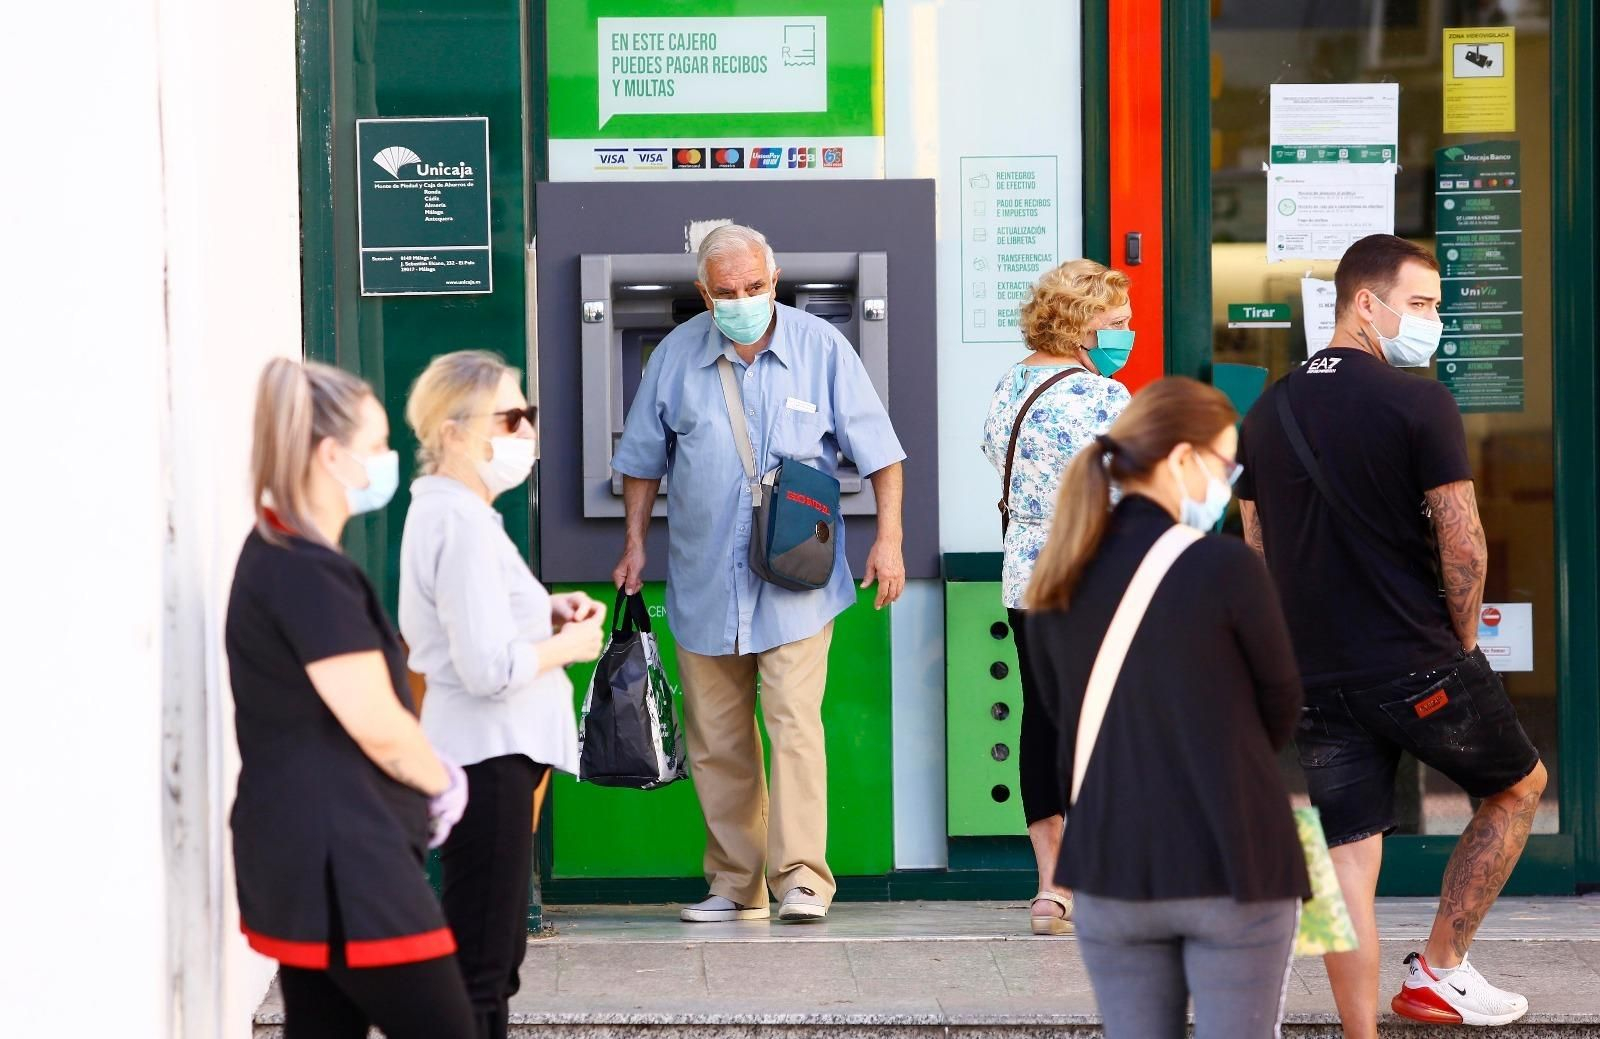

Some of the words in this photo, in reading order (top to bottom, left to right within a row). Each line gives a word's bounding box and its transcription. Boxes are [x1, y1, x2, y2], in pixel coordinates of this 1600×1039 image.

[612, 33, 628, 50] EN
[632, 33, 665, 50] ESTE
[668, 32, 717, 50] CAJERO
[612, 56, 662, 74] PUEDES
[666, 56, 708, 74] PAGAR
[712, 56, 768, 73] RECIBOS
[612, 80, 620, 97] Y
[624, 79, 675, 96] MULTAS
[600, 154, 625, 163] VISA
[638, 153, 663, 162] VISA
[752, 152, 780, 160] UnionPay
[788, 154, 815, 162] JCB
[416, 162, 474, 178] Unicaja
[996, 172, 1036, 180] REINTEGROS
[996, 182, 1005, 190] DE
[1006, 181, 1036, 190] EFECTIVO
[996, 199, 1013, 208] PAGO
[1014, 199, 1023, 208] DE
[1024, 198, 1051, 207] RECIBOS
[996, 209, 1001, 217] E
[1002, 208, 1038, 217] IMPUESTOS
[997, 225, 1046, 235] ACTUALIZACIÓN
[997, 236, 1005, 245] DE
[1007, 236, 1036, 244] LIBRETAS
[997, 254, 1052, 262] TRANSFERENCIAS
[997, 264, 1002, 272] Y
[1003, 263, 1040, 272] TRASPASOS
[1008, 291, 1025, 299] CUEN
[998, 309, 1021, 317] RECAR
[1243, 307, 1275, 318] Tirar
[998, 319, 1005, 327] DE
[1308, 357, 1342, 369] EA7
[786, 490, 831, 516] HONDA
[648, 606, 667, 618] CEN
